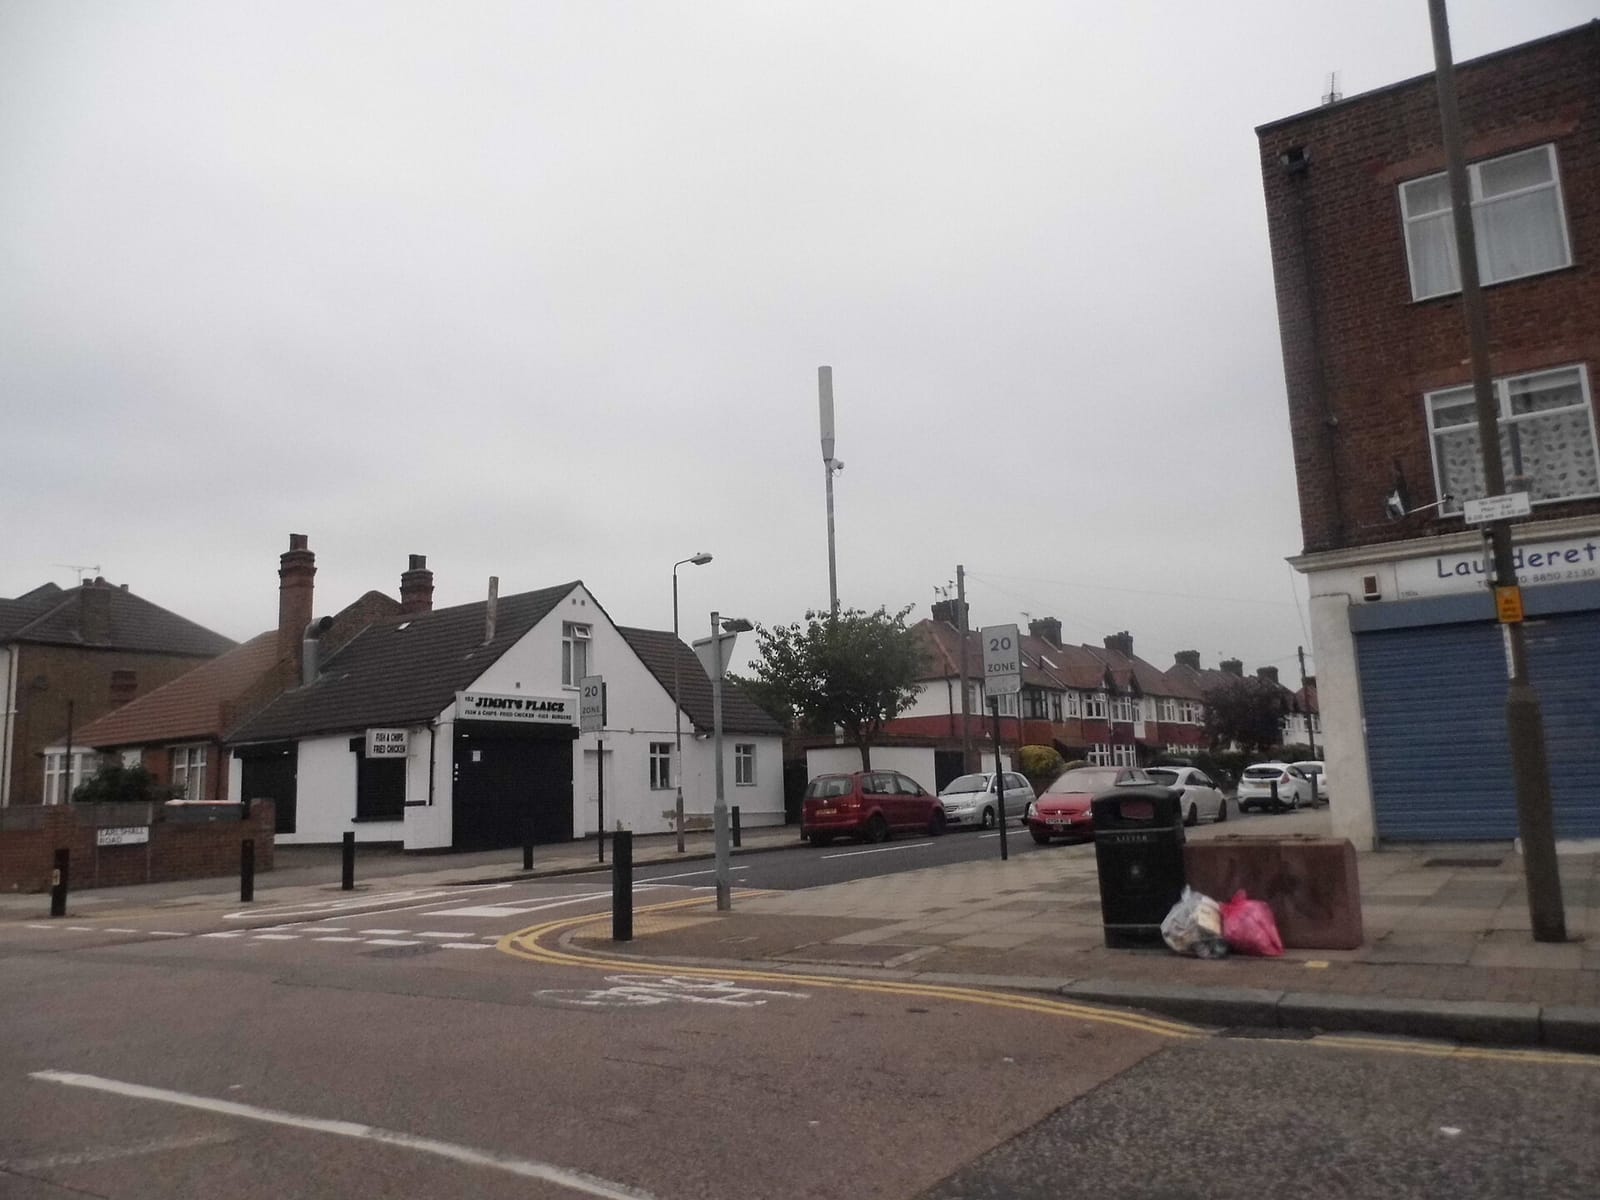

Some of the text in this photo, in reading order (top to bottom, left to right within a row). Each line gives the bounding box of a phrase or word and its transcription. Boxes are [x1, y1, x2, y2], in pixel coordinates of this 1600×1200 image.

[990, 637, 1011, 651] 20
[988, 662, 1016, 672] ZONE
[584, 686, 598, 697] 20
[476, 697, 523, 710] JIMMY'S
[526, 700, 565, 712] PLAICE
[582, 706, 600, 714] ZONE
[376, 732, 386, 742] FISH
[391, 732, 404, 742] CHIPS
[374, 744, 406, 753] FRIED CHICKEN
